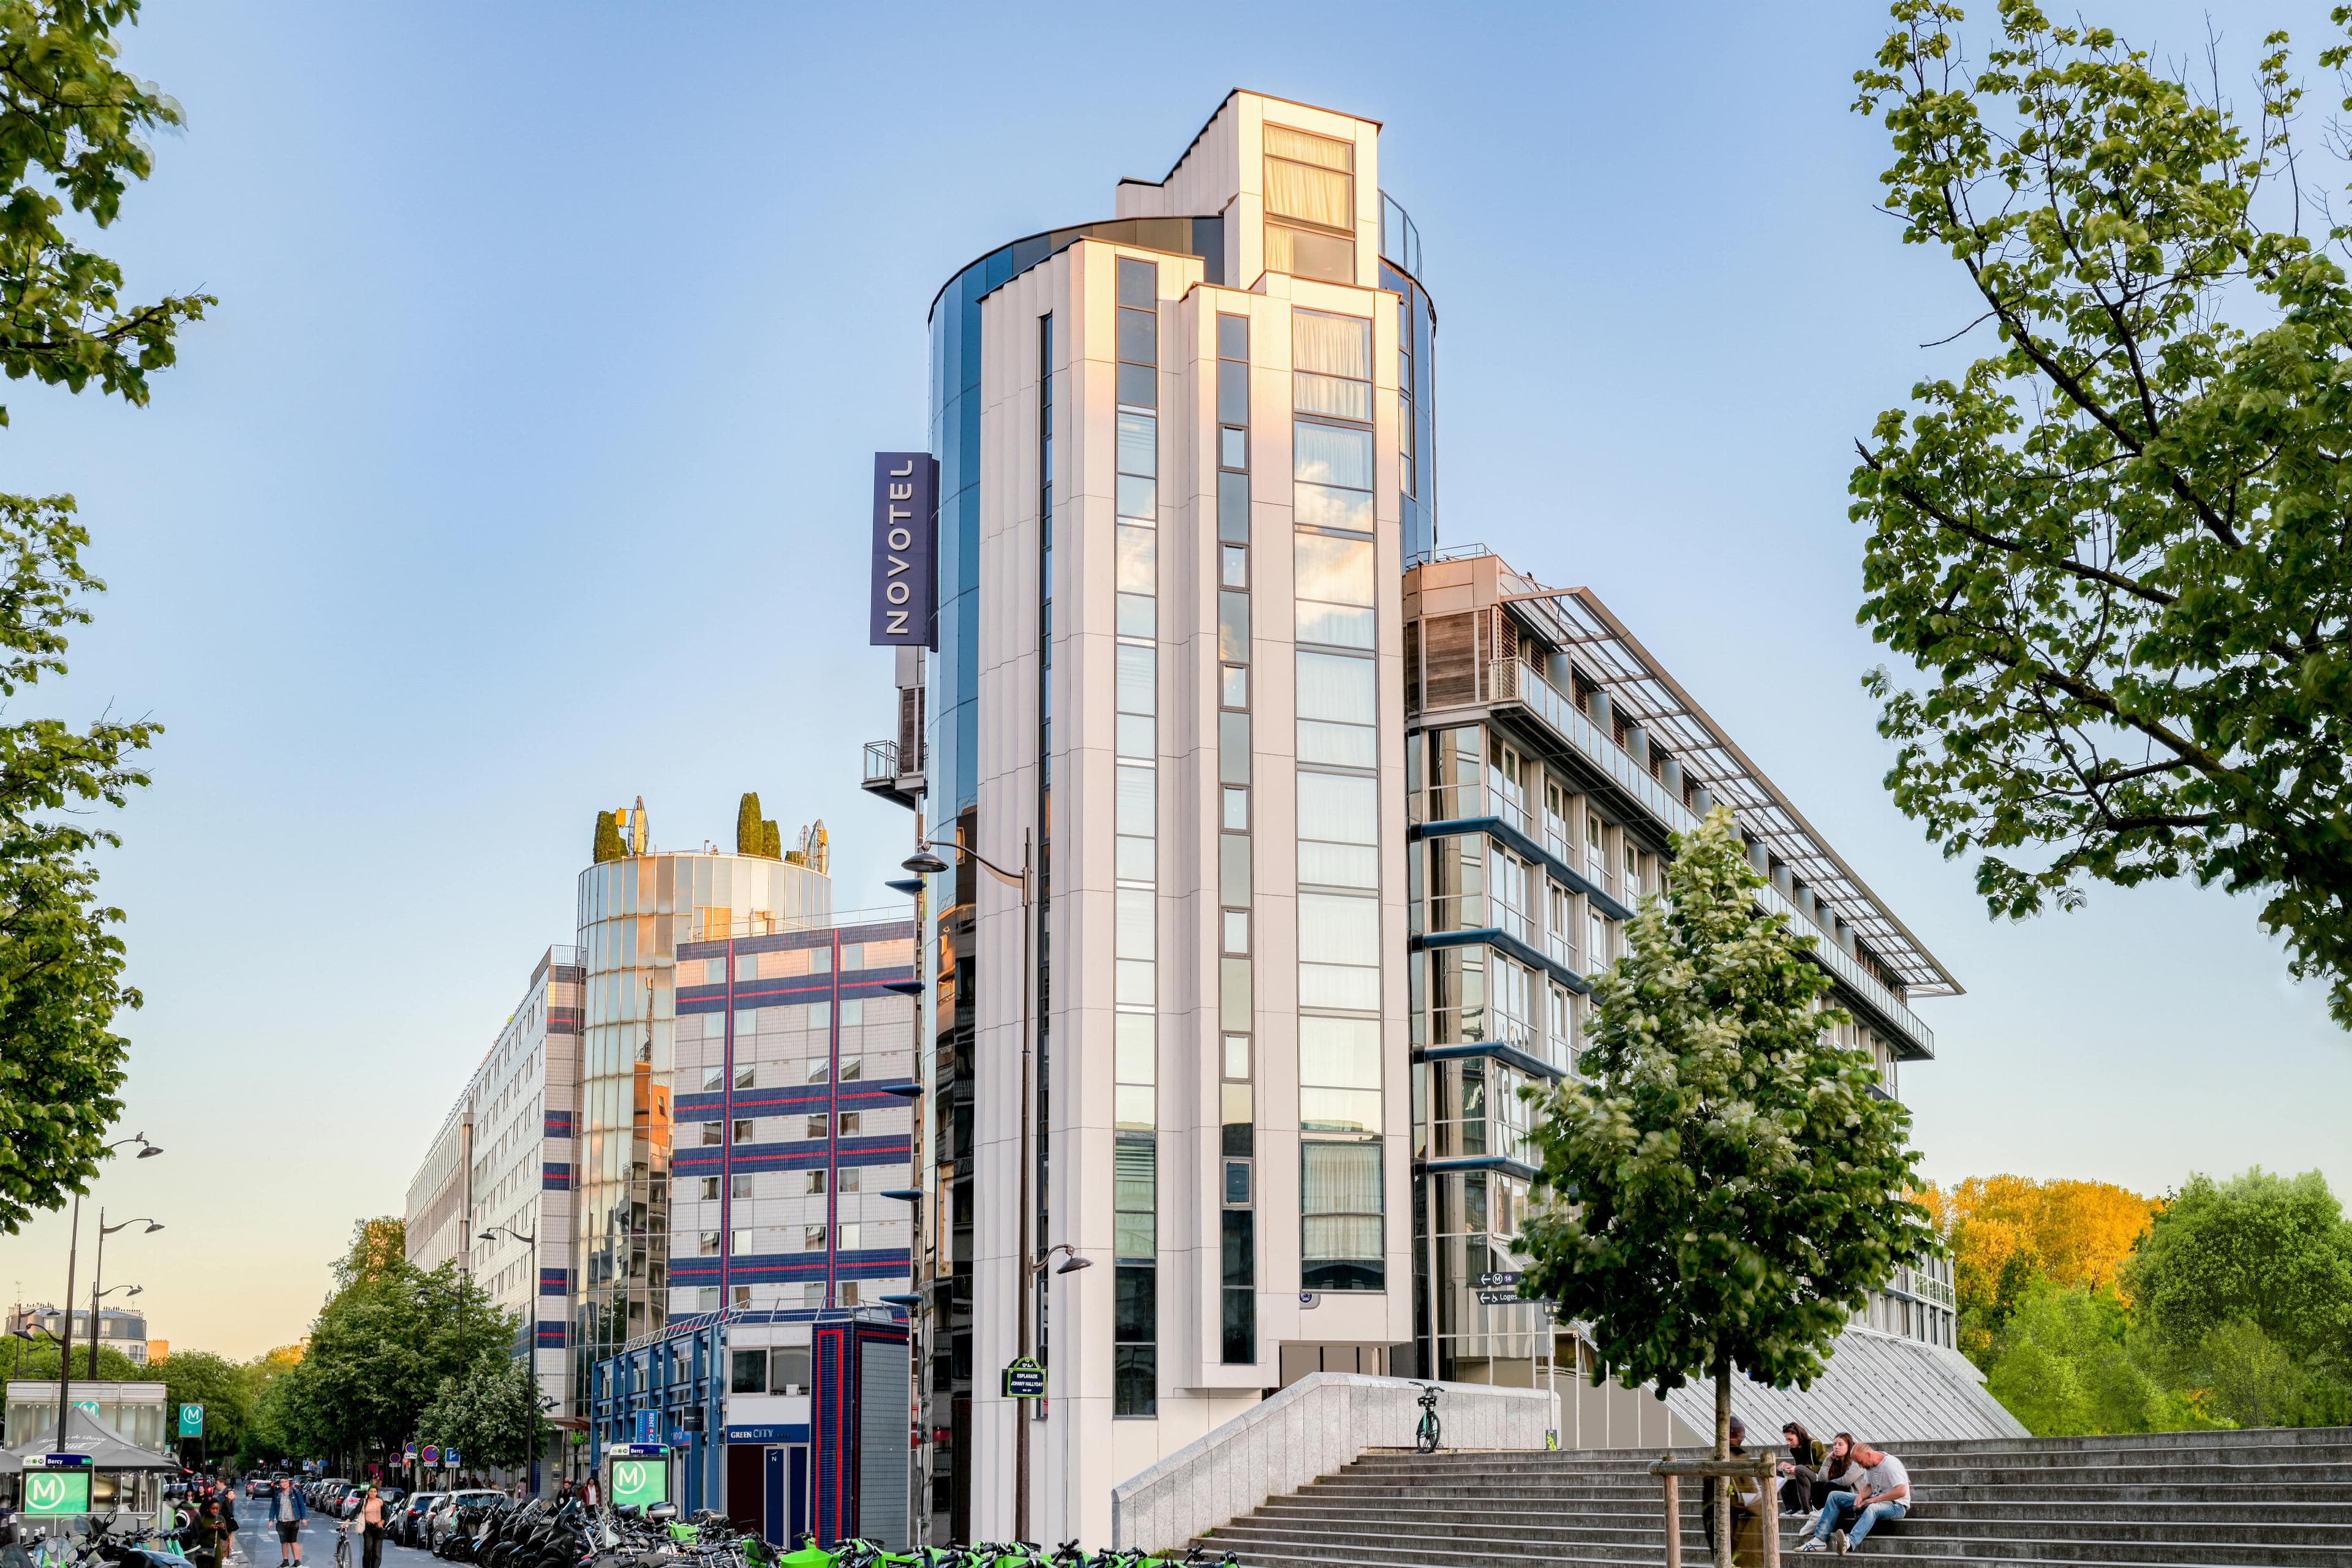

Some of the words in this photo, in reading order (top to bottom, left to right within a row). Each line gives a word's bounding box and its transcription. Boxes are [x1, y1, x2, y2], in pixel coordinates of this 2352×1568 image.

[886, 461, 913, 634] NOVOTEL
[188, 1409, 199, 1420] M
[753, 1428, 774, 1438] CITY
[619, 1467, 638, 1486] M
[34, 1480, 55, 1500] M
